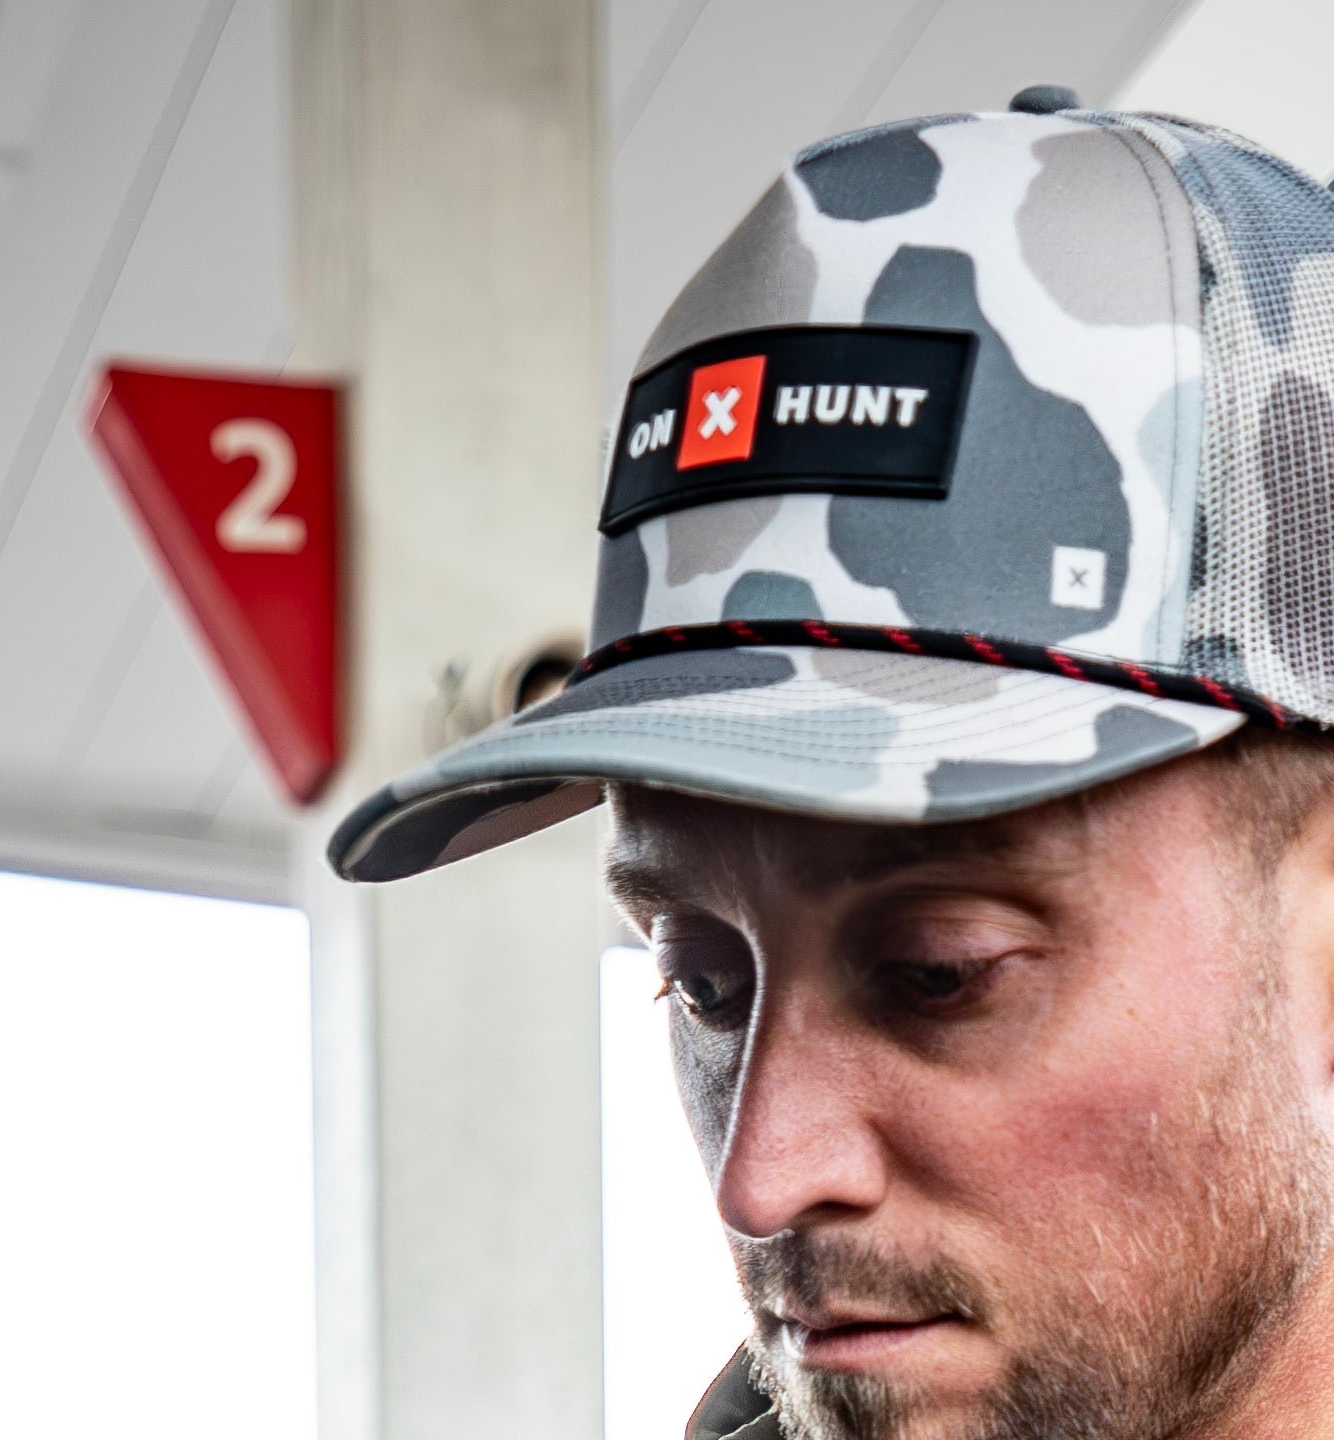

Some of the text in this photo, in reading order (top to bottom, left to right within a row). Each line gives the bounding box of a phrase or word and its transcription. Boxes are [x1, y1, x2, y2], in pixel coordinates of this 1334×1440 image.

[628, 410, 675, 460] ON
[774, 385, 929, 428] HUNT
[208, 416, 308, 555] 2
